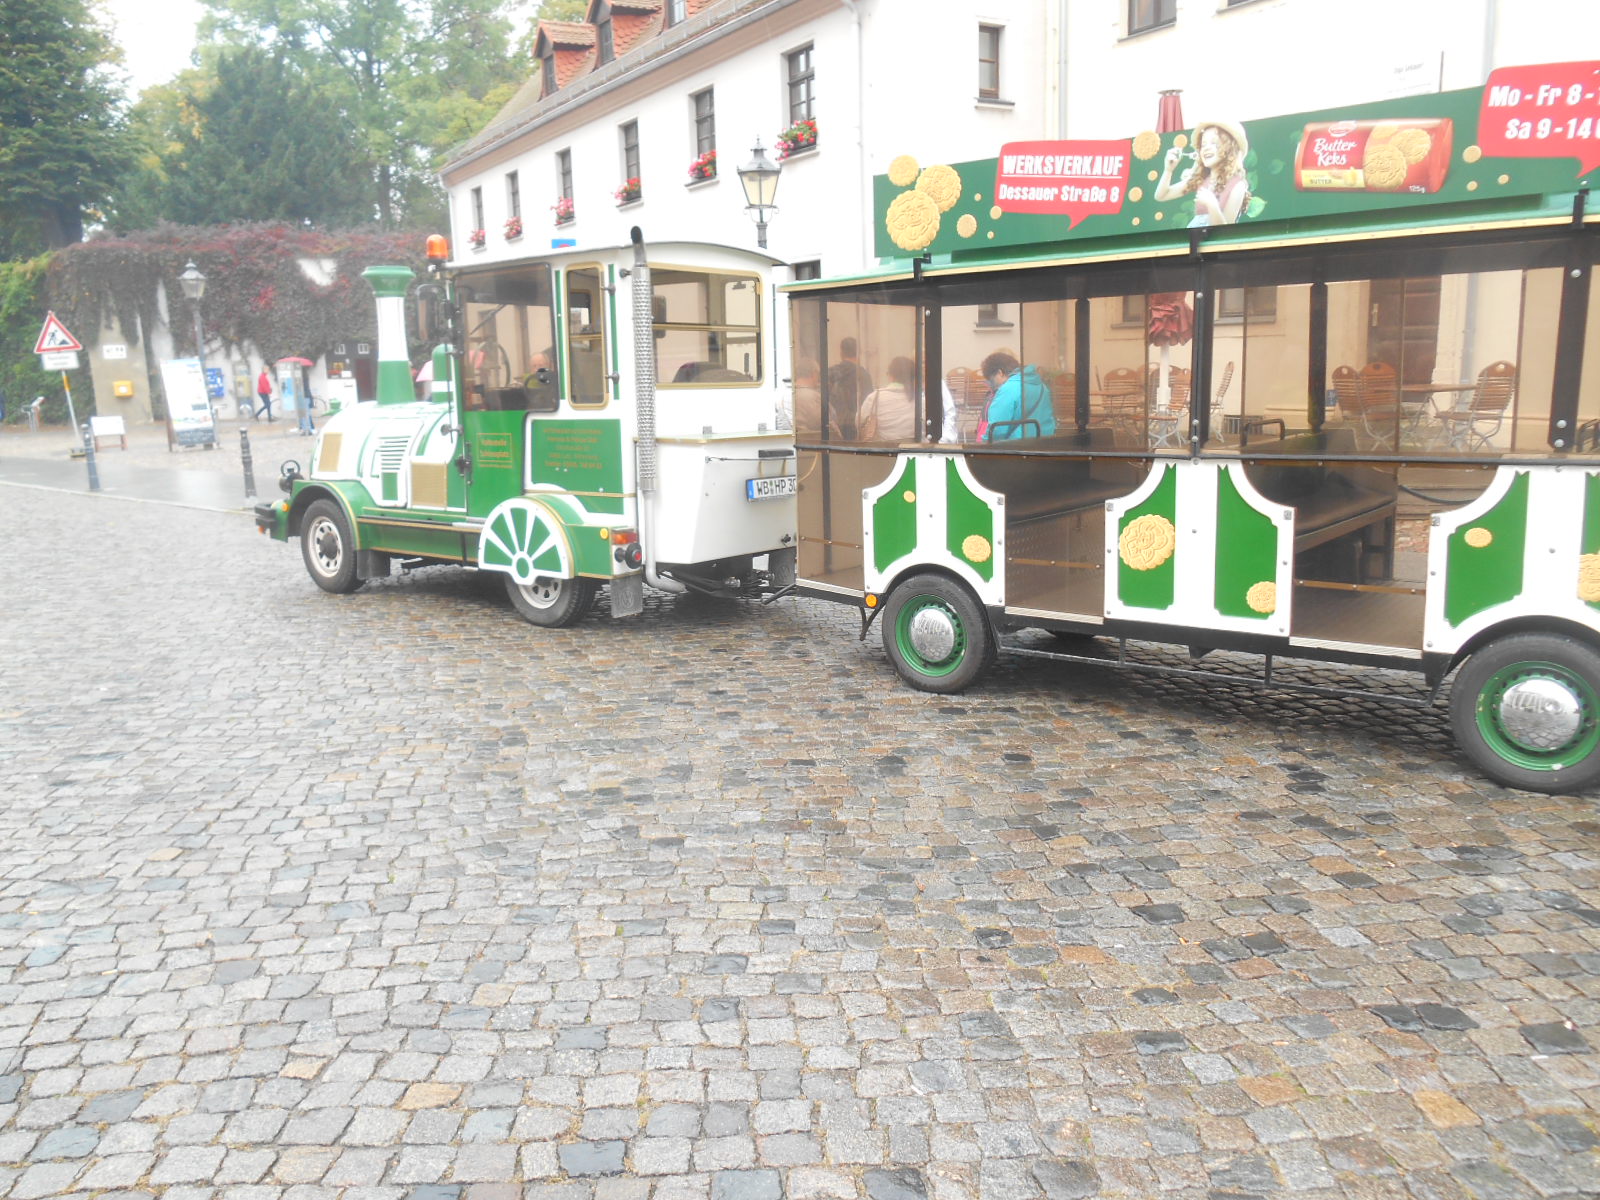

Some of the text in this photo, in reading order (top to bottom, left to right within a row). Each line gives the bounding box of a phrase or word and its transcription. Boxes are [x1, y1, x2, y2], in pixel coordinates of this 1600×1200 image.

[1566, 84, 1582, 105] 8
[1505, 118, 1532, 140] Sa
[1313, 137, 1357, 154] Butter
[1002, 155, 1124, 176] WERKSVERKAUF
[1317, 151, 1348, 167] Keks
[999, 184, 1120, 203] Dessauer Straße 8
